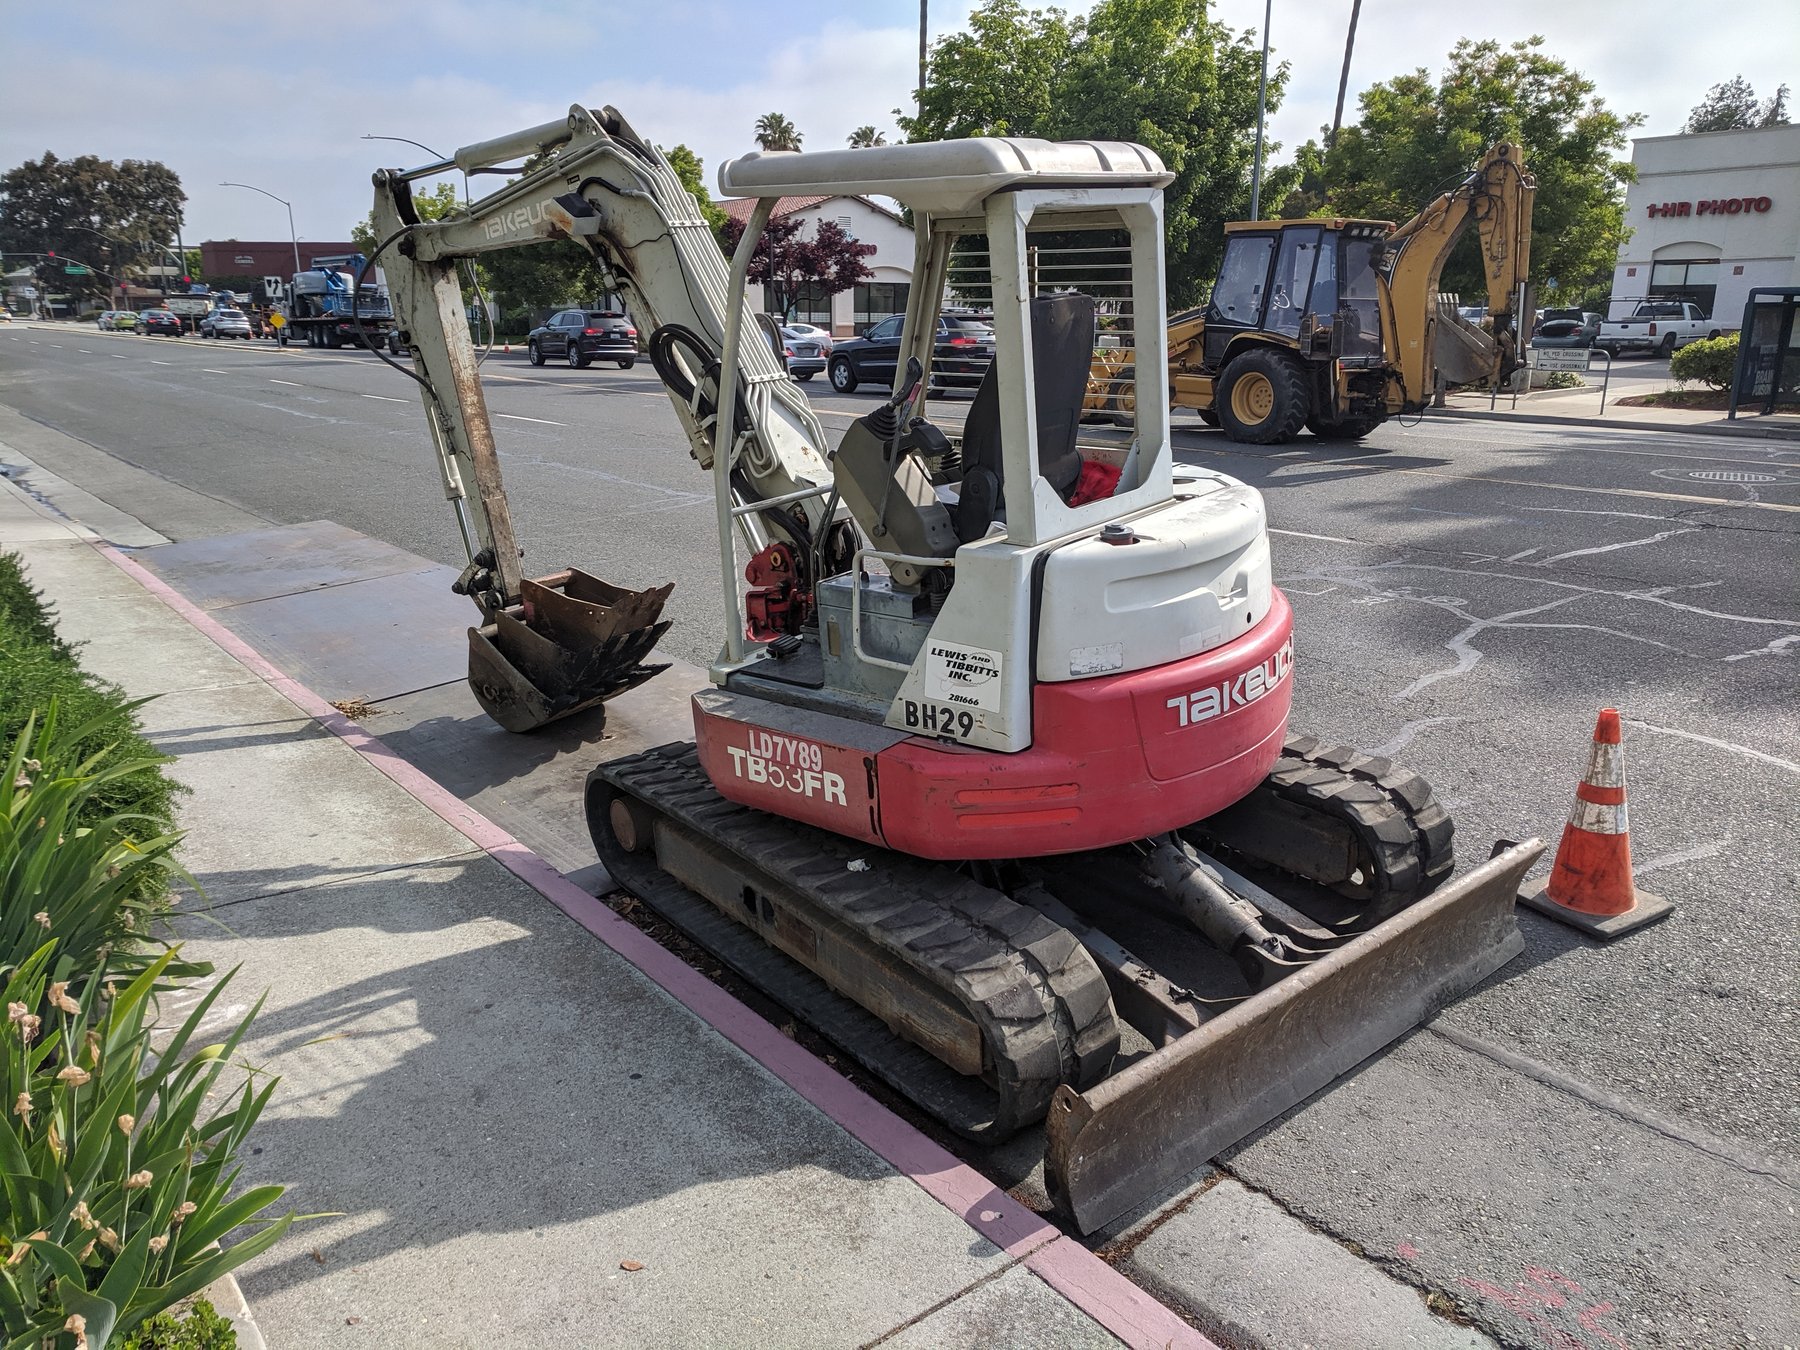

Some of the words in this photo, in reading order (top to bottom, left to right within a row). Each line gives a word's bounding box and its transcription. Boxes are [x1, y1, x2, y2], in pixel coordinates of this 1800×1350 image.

[1646, 203, 1692, 218] 1-HR
[1696, 196, 1772, 216] PHOTO
[931, 647, 968, 661] LEWIS
[945, 660, 999, 677] TIBBITTS
[948, 670, 972, 682] INC.
[948, 693, 979, 706] 281666
[905, 700, 974, 738] BH29
[748, 729, 823, 772] LD7Y89
[727, 745, 848, 807] TB53FR
